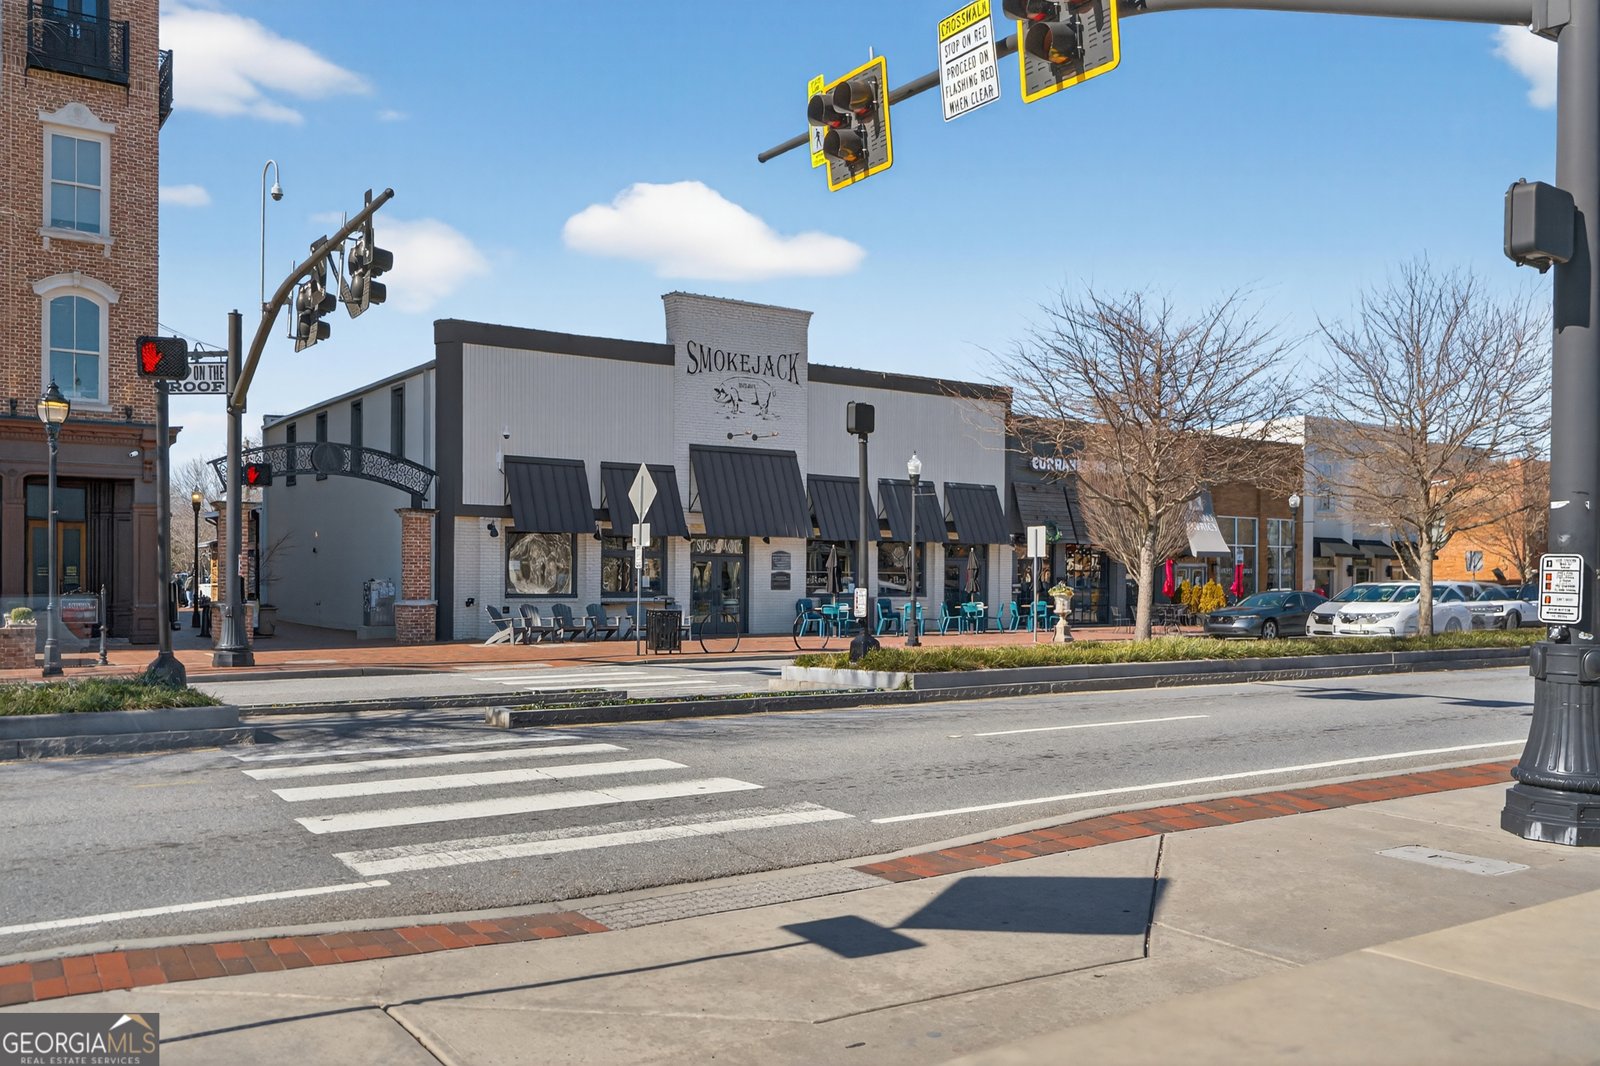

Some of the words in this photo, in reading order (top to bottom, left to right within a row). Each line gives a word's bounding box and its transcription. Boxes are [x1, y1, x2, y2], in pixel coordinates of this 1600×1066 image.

[940, 0, 987, 37] CROSSWALK
[944, 40, 960, 58] STOP
[962, 34, 971, 49] ON
[974, 25, 987, 42] RED
[946, 55, 977, 80] PROCEED
[979, 49, 989, 64] ON
[945, 73, 978, 98] FLASHING
[980, 65, 994, 83] RED
[949, 95, 969, 114] WHEN
[971, 84, 994, 105] CLEAR
[193, 365, 205, 380] ON
[208, 365, 225, 380] THE
[687, 340, 800, 385] SMOKEJACK
[168, 381, 225, 392] ROOF
